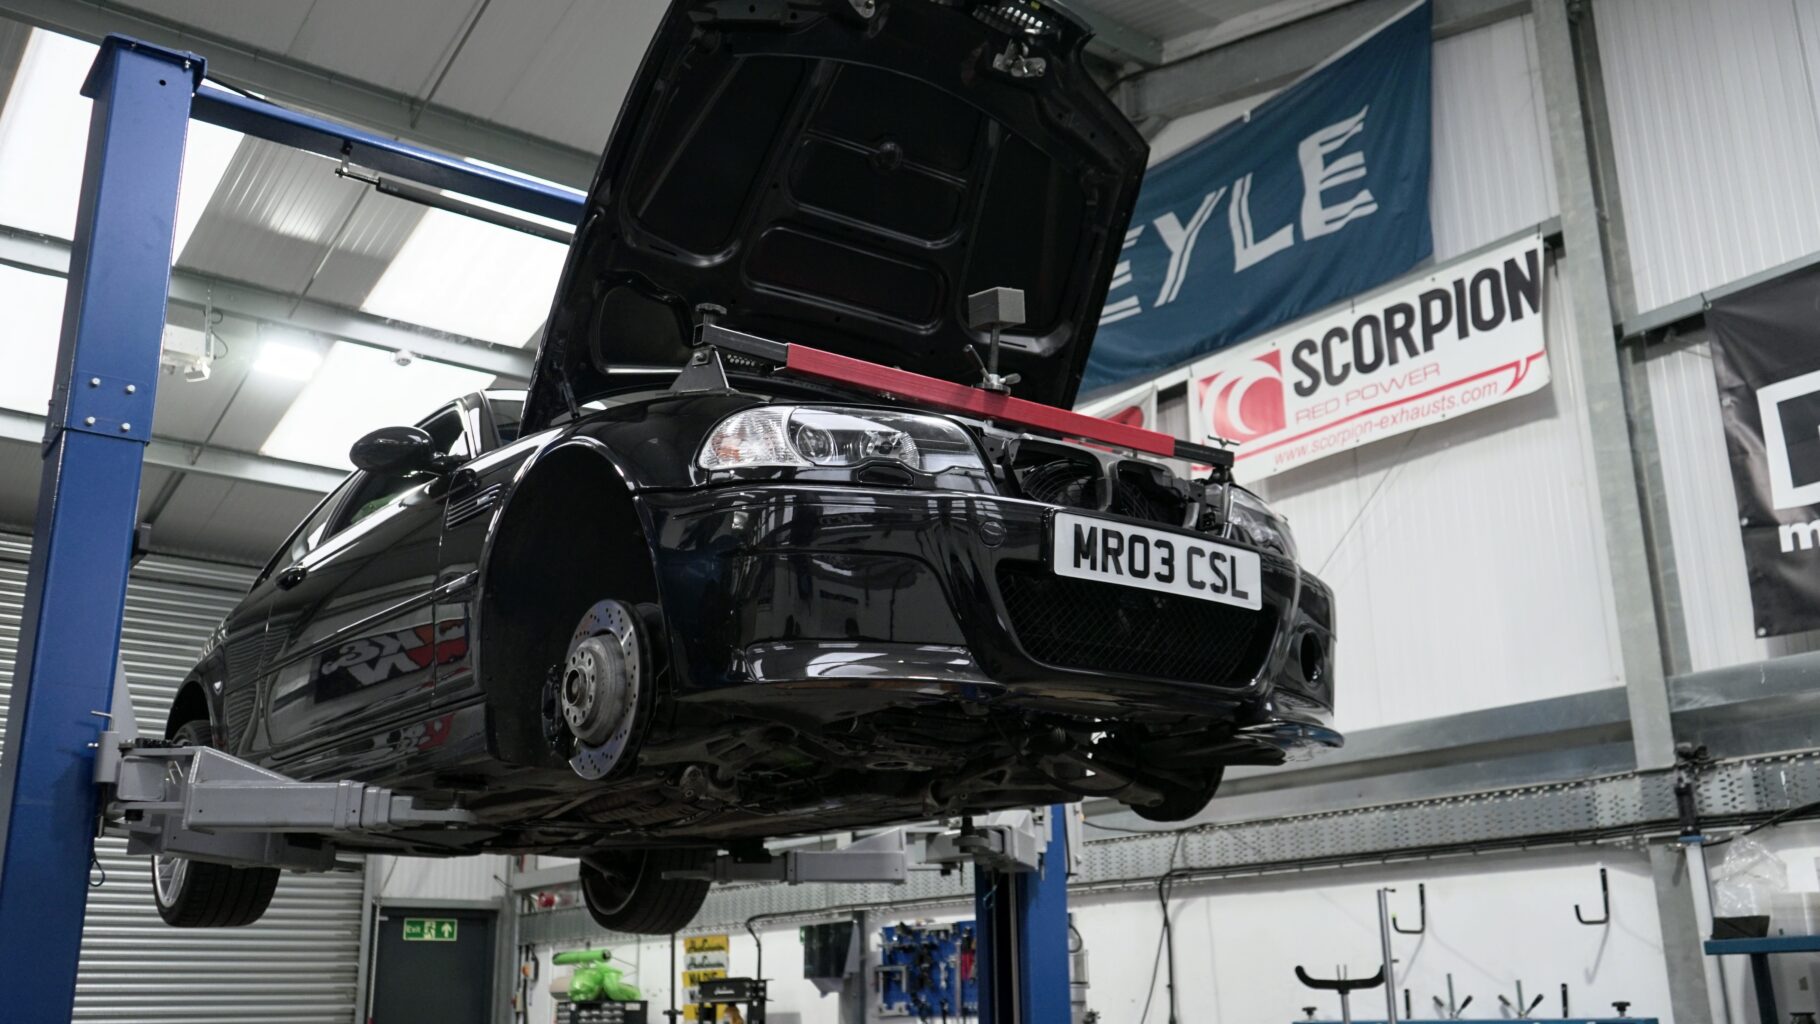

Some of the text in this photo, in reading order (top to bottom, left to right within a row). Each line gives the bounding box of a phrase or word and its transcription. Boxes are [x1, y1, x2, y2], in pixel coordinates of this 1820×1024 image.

[1291, 248, 1541, 398] SCORPION
[1274, 381, 1498, 466] www.scorpion-exhausts.com
[1294, 362, 1441, 425] RED POWER
[1073, 523, 1249, 600] MR03 CSL
